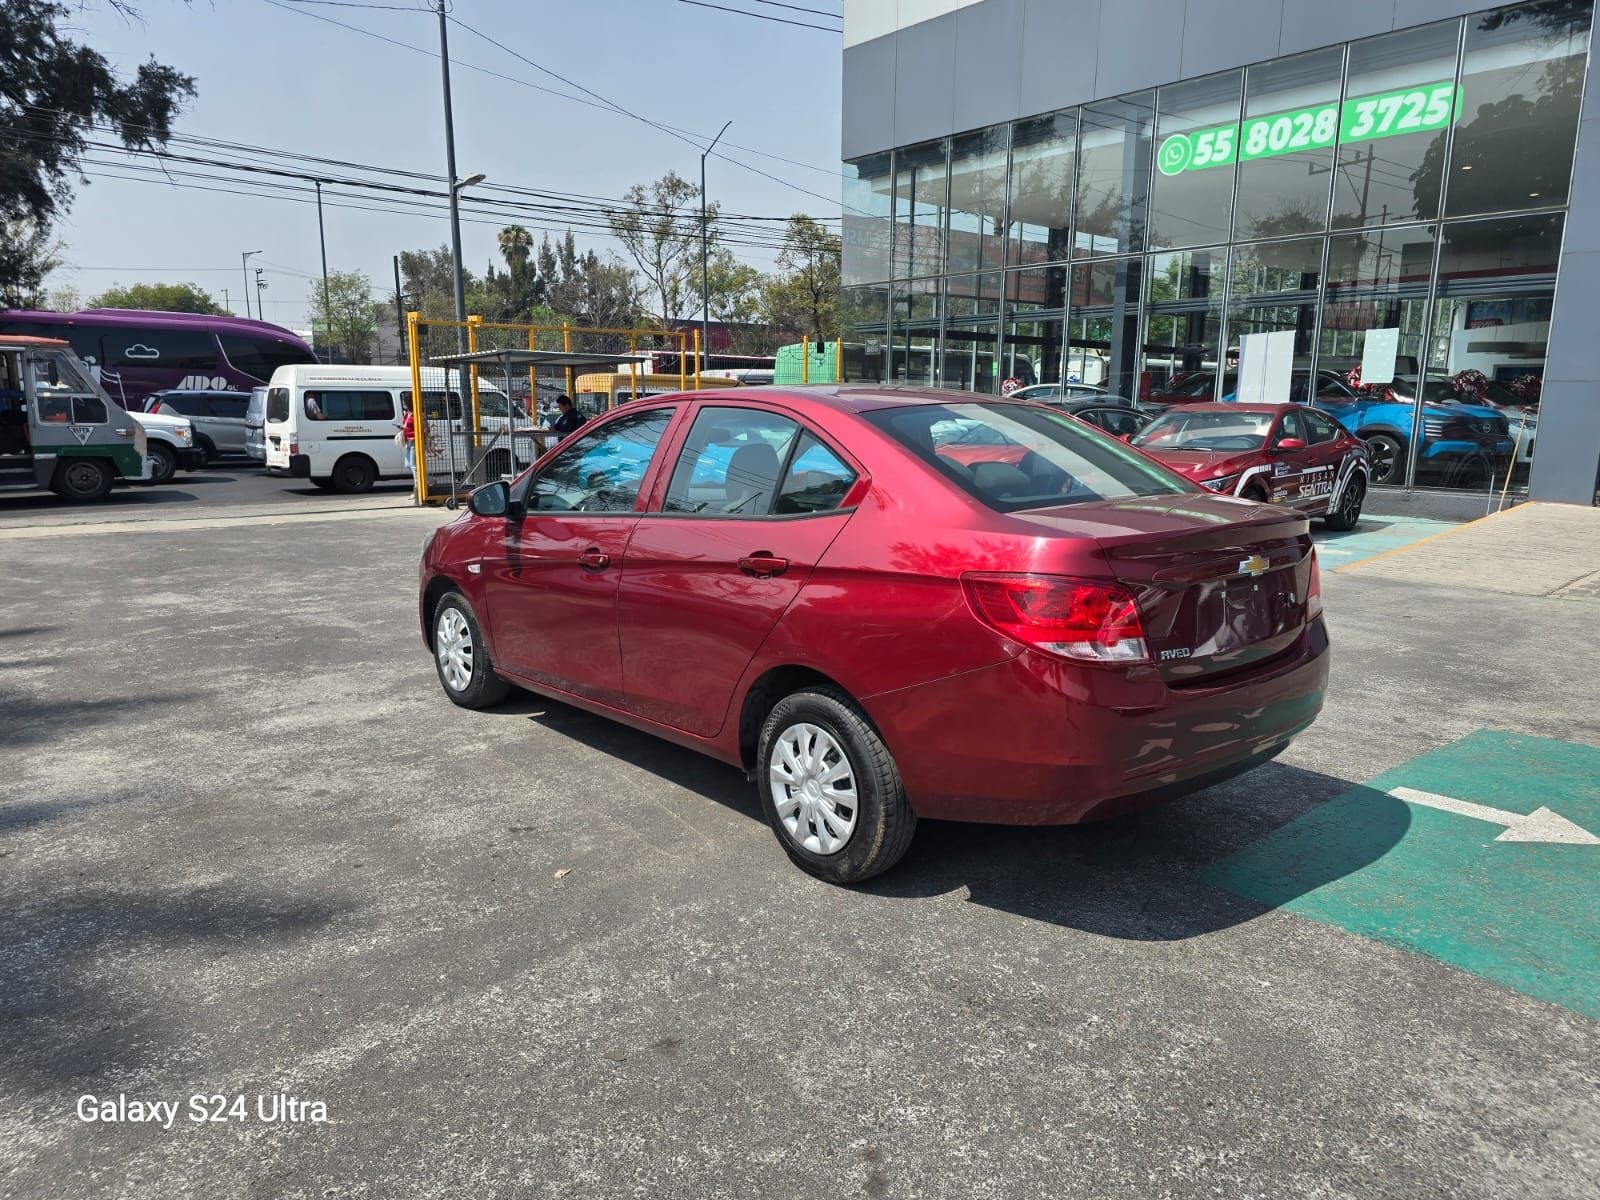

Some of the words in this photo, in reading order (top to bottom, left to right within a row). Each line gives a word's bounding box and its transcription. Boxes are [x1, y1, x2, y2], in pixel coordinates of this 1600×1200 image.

[1193, 130, 1232, 166] 55
[1246, 109, 1337, 154] 8028
[1351, 88, 1451, 137] 3725
[176, 375, 227, 390] ADO
[1299, 470, 1334, 484] NISSAN
[1298, 481, 1332, 498] SENTRA
[1160, 648, 1190, 659] AVEO
